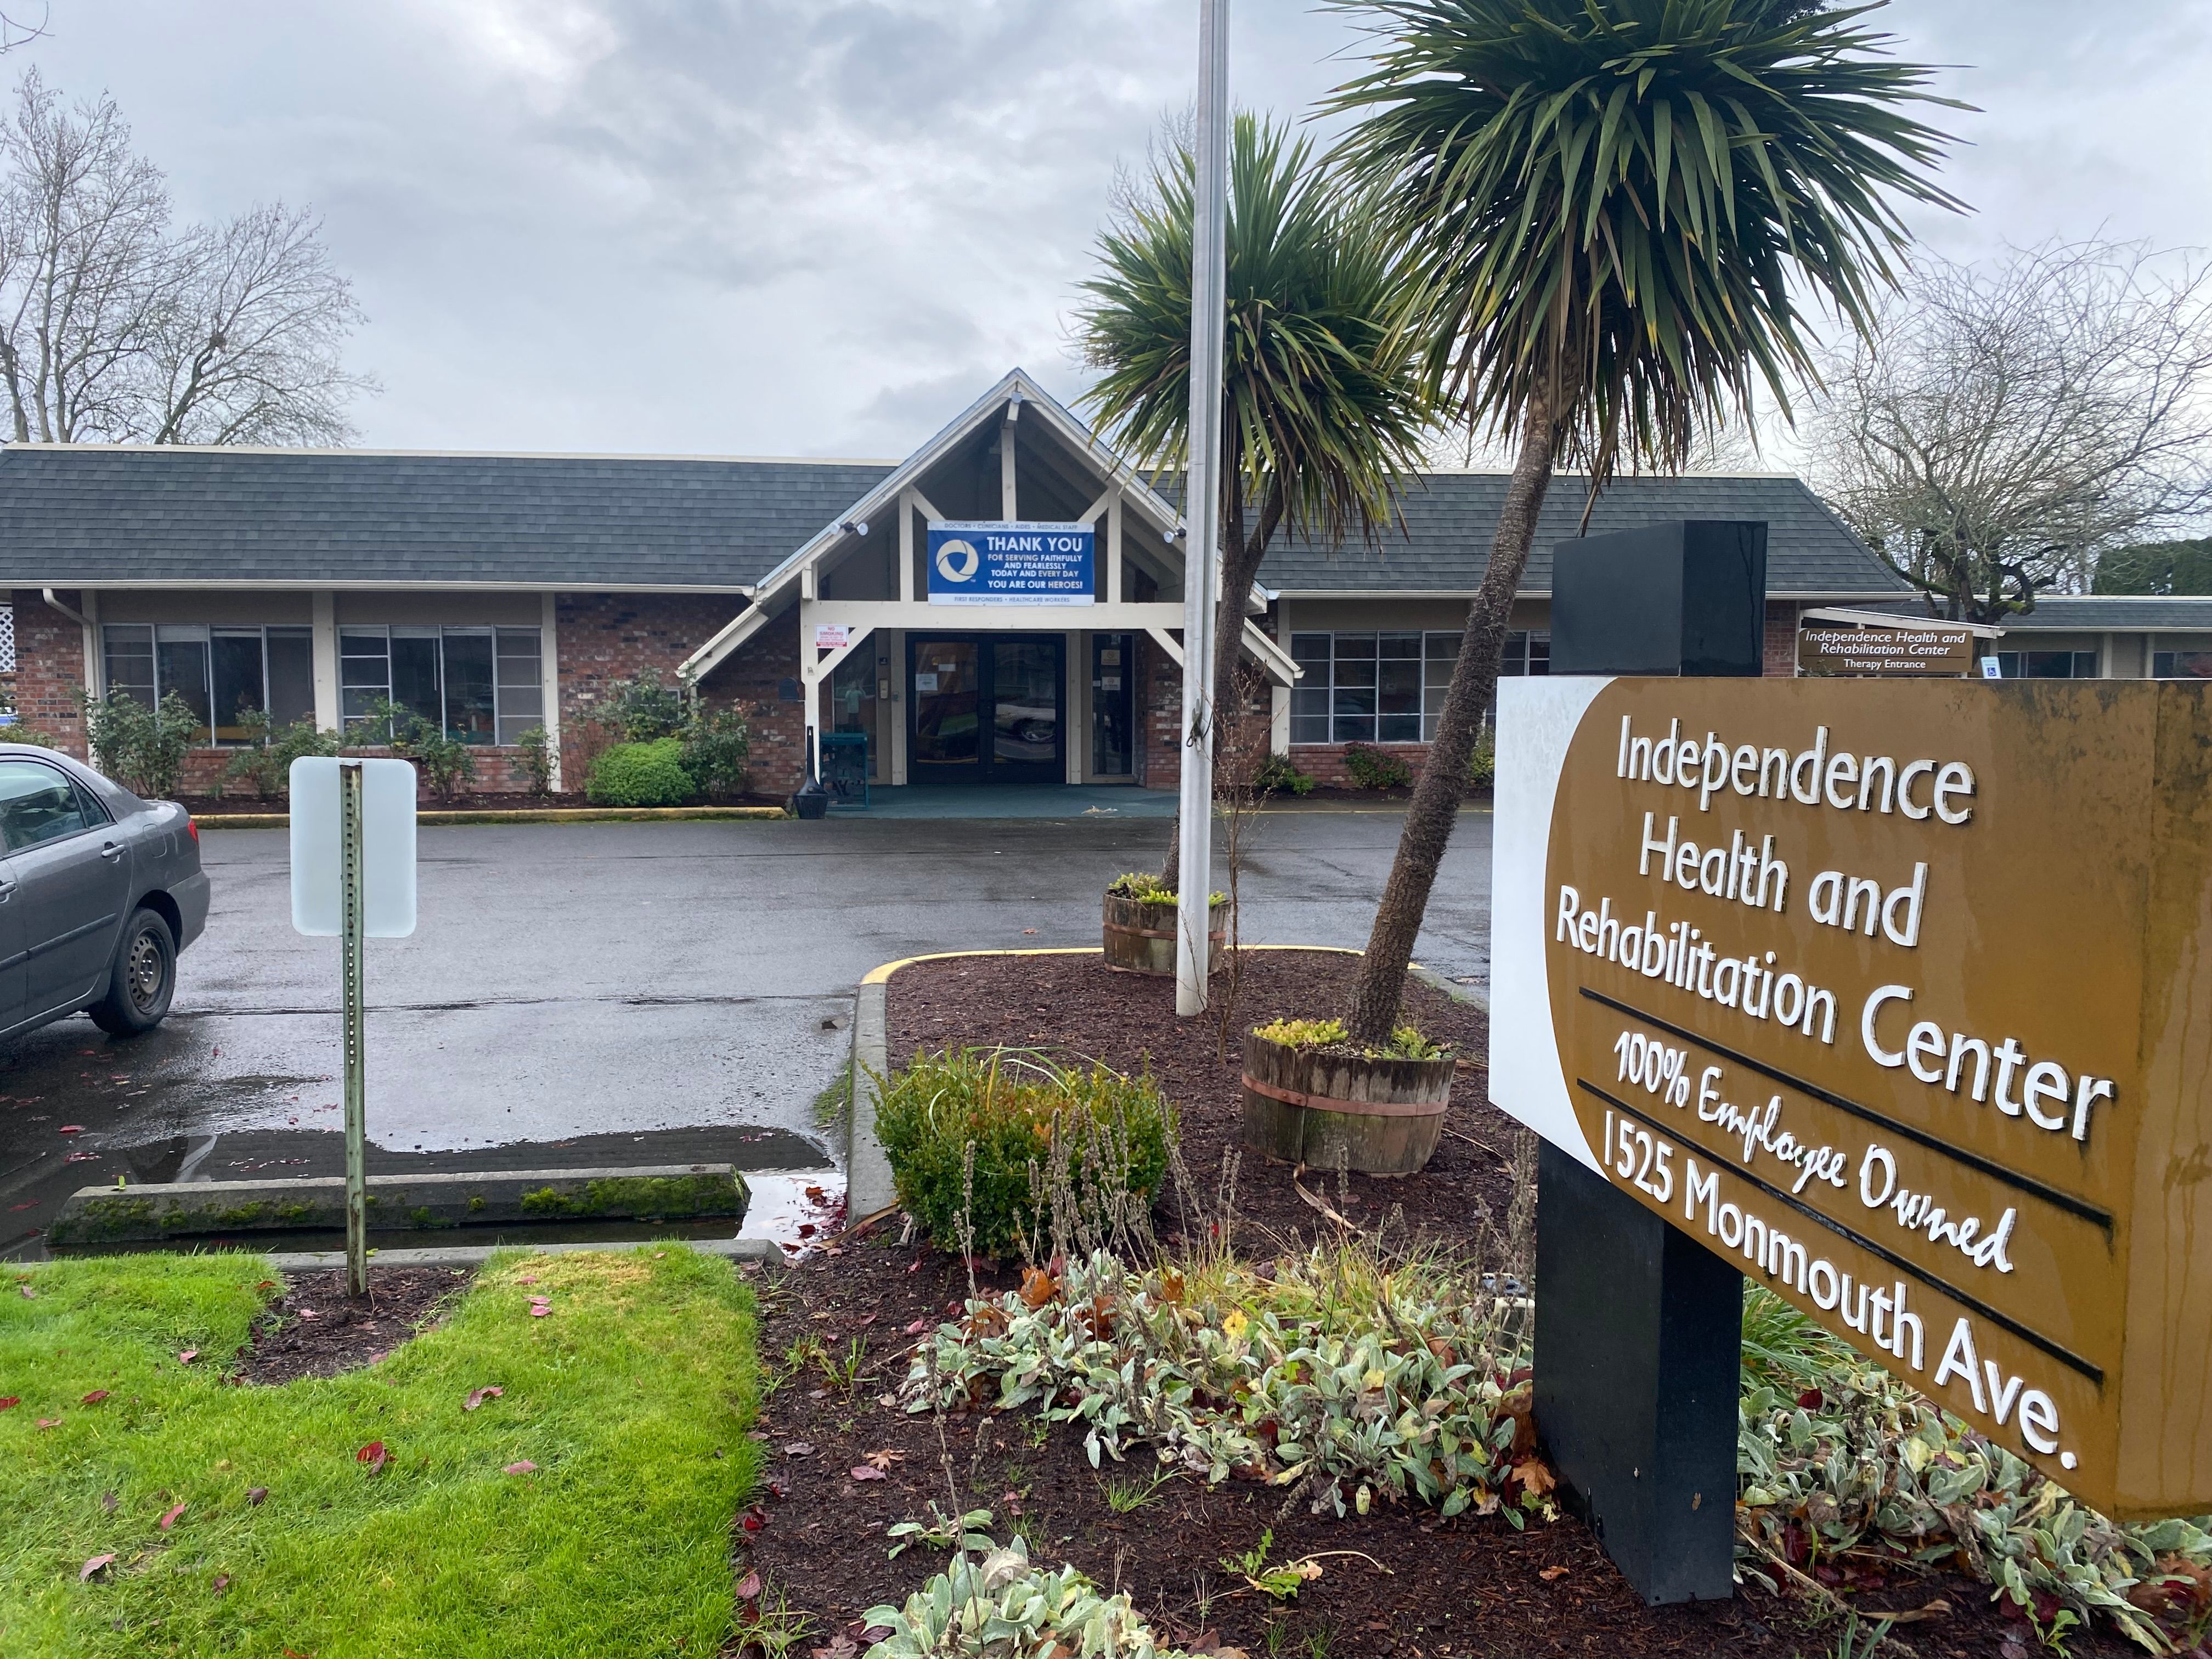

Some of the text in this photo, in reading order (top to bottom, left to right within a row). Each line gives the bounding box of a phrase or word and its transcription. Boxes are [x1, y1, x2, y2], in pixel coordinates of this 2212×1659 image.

[986, 536, 1082, 552] THANK YOU
[1027, 580, 1046, 589] OUR
[1048, 580, 1083, 589] HEROES!
[1805, 630, 1966, 644] Independence Health and
[1820, 642, 1950, 655] Rehabilitation Center
[1843, 659, 1926, 670] Therapy Entrance
[1617, 715, 1975, 825] Independence
[1639, 811, 1928, 947] Health and
[1556, 884, 2114, 1141] Rehabilitation Center
[1613, 1031, 2017, 1273] 100% Employee Owned
[1604, 1110, 2078, 1470] 1525 Monmouth Ave.
